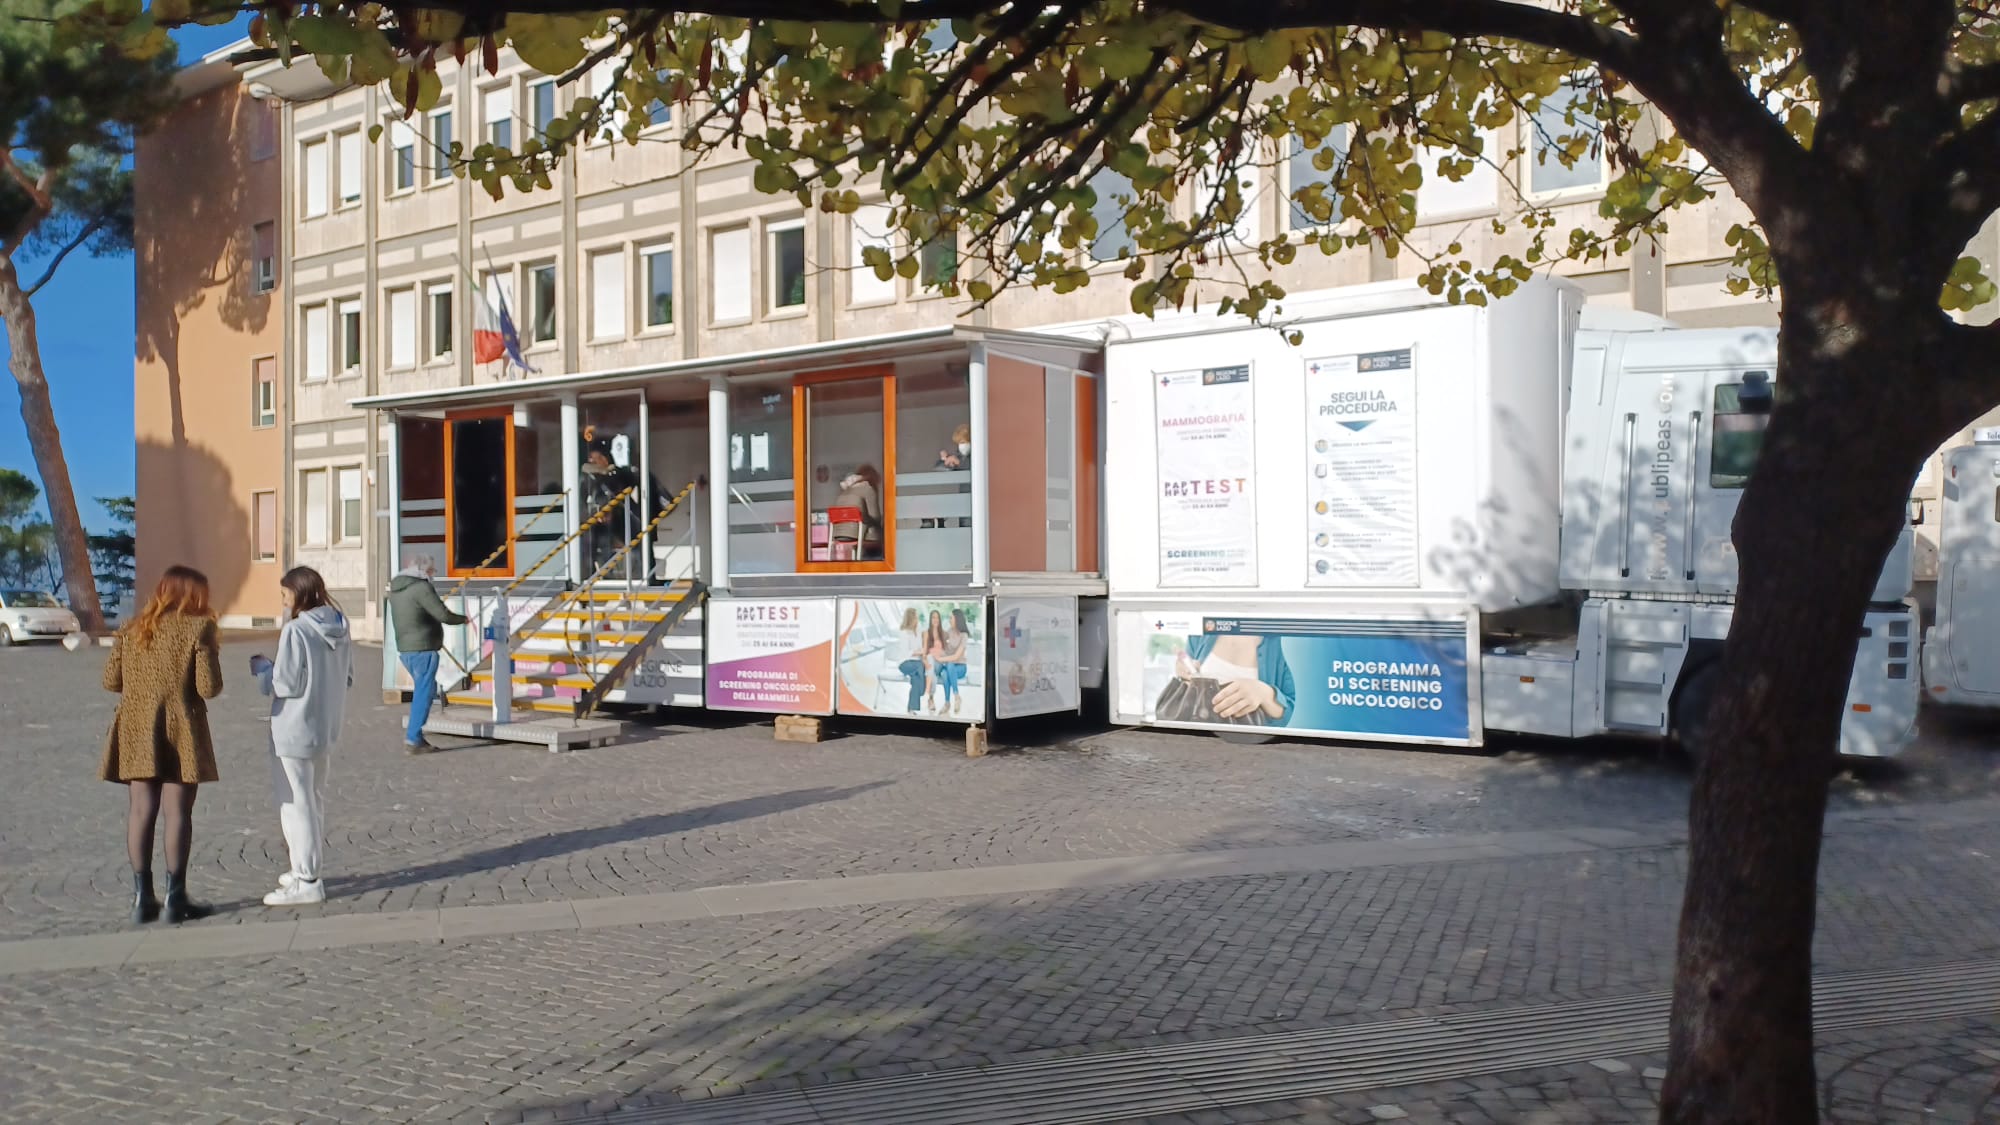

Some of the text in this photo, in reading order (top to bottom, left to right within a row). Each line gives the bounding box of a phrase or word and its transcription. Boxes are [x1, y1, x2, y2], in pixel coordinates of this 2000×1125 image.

[1331, 389, 1385, 404] SEGUI LA
[1319, 401, 1397, 416] PROCEDURA
[1162, 413, 1246, 428] MAMMOGRAFIA
[1164, 478, 1247, 495] PAP TEST
[1167, 550, 1226, 558] SCREENING
[736, 606, 800, 620] PAP TEST
[737, 670, 798, 680] PROGRAMMA DI
[1333, 660, 1442, 677] PROGRAMMA
[633, 674, 667, 688] LAZIO
[719, 680, 816, 693] SCREENING ONCOLOGICO
[1328, 676, 1442, 694] DI SCREENING
[733, 692, 800, 703] DELLA MAMMELLA
[1329, 692, 1443, 711] ONCOLOGICO
